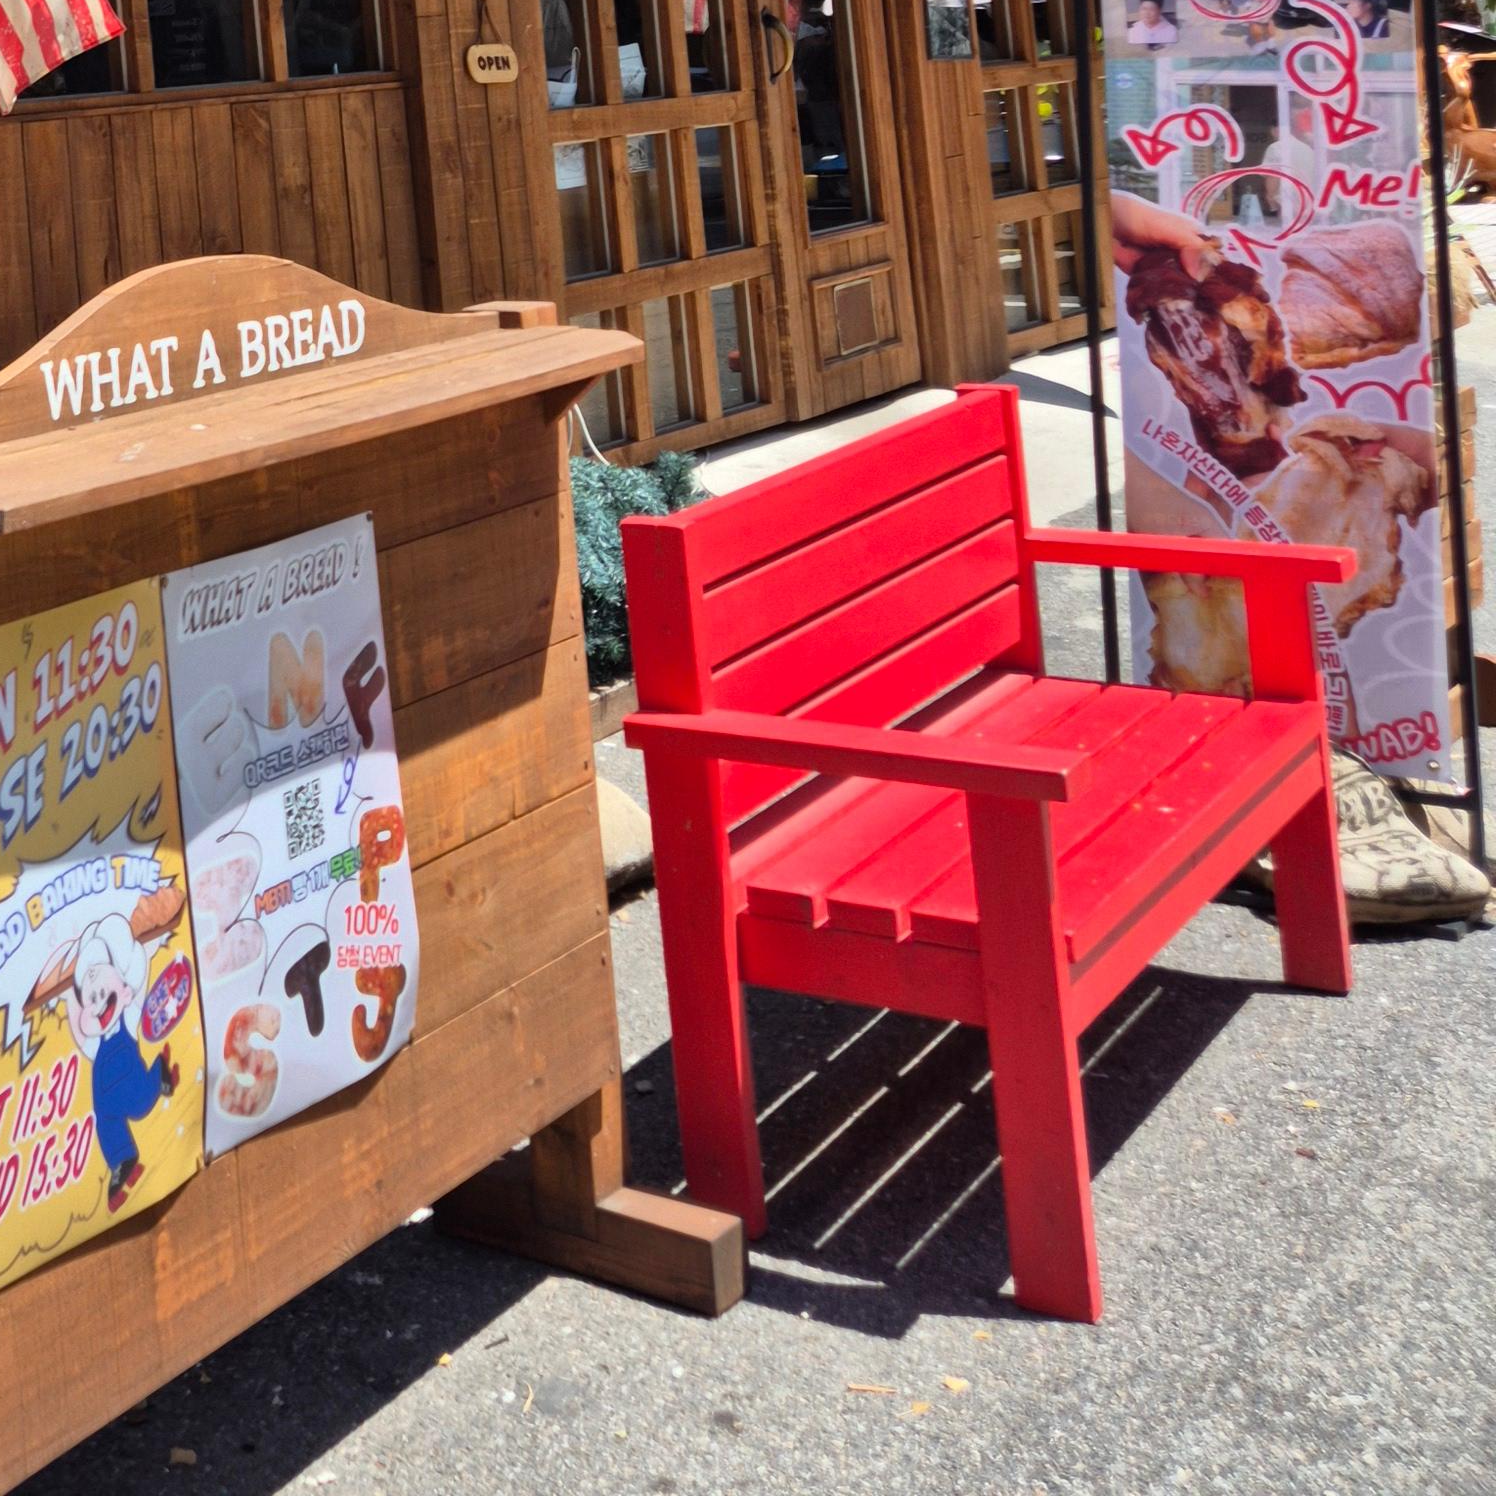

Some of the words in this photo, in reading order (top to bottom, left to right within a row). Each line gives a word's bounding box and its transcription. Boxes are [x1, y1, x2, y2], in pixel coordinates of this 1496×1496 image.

[477, 55, 511, 71] OPEN
[39, 336, 178, 420] WHAT
[192, 329, 226, 389] A
[238, 299, 365, 378] BREAD
[1244, 505, 1290, 544] 등장
[182, 571, 257, 634] WHAT
[257, 564, 280, 614] A
[282, 542, 346, 604] BREAD
[32, 601, 139, 733] 11:30
[60, 661, 162, 801] 20:30
[26, 857, 107, 932] BAKING
[111, 854, 161, 894] TIME
[344, 904, 399, 936] 100%
[362, 944, 403, 969] EVENT
[13, 1054, 78, 1143] 11:30
[22, 1116, 93, 1207] 15:30
